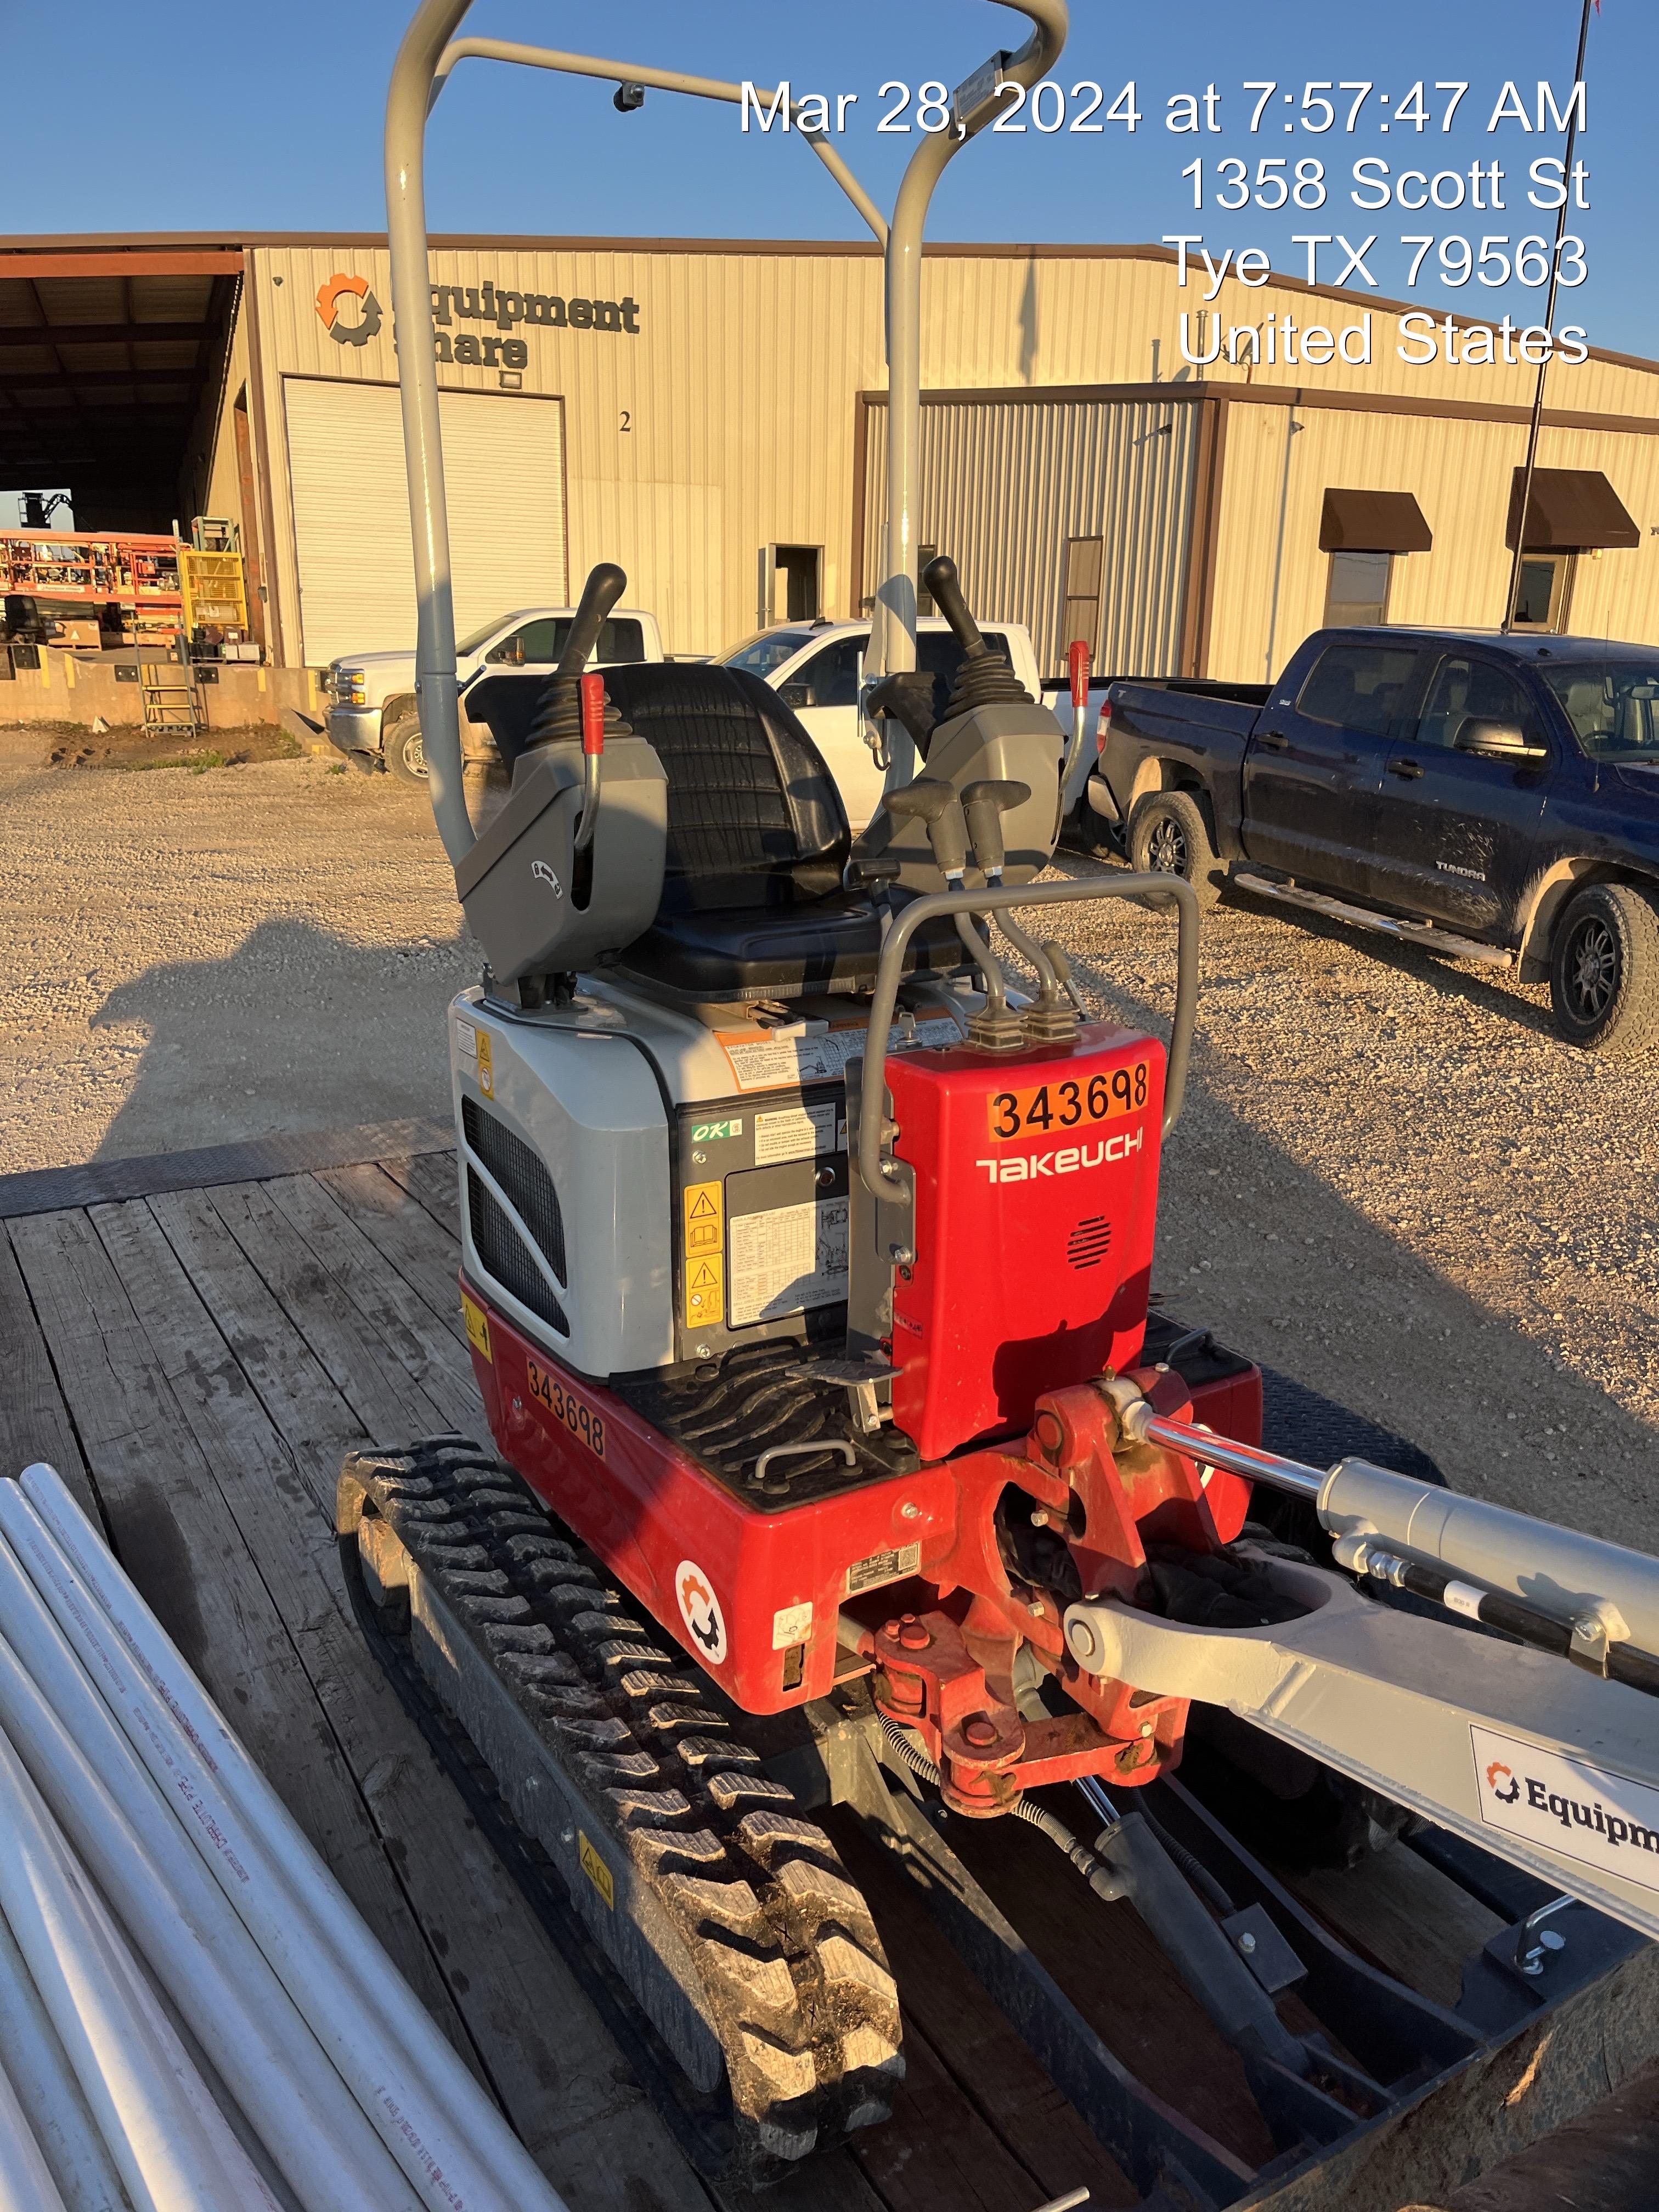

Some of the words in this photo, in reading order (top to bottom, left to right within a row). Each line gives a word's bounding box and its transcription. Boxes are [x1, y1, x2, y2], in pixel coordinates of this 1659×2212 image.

[393, 280, 640, 334] quipment
[619, 410, 631, 432] 2
[1435, 860, 1486, 882] TUNDRA
[992, 1063, 1147, 1138] 343698
[693, 1121, 729, 1141] OK
[528, 1361, 604, 1456] 343698
